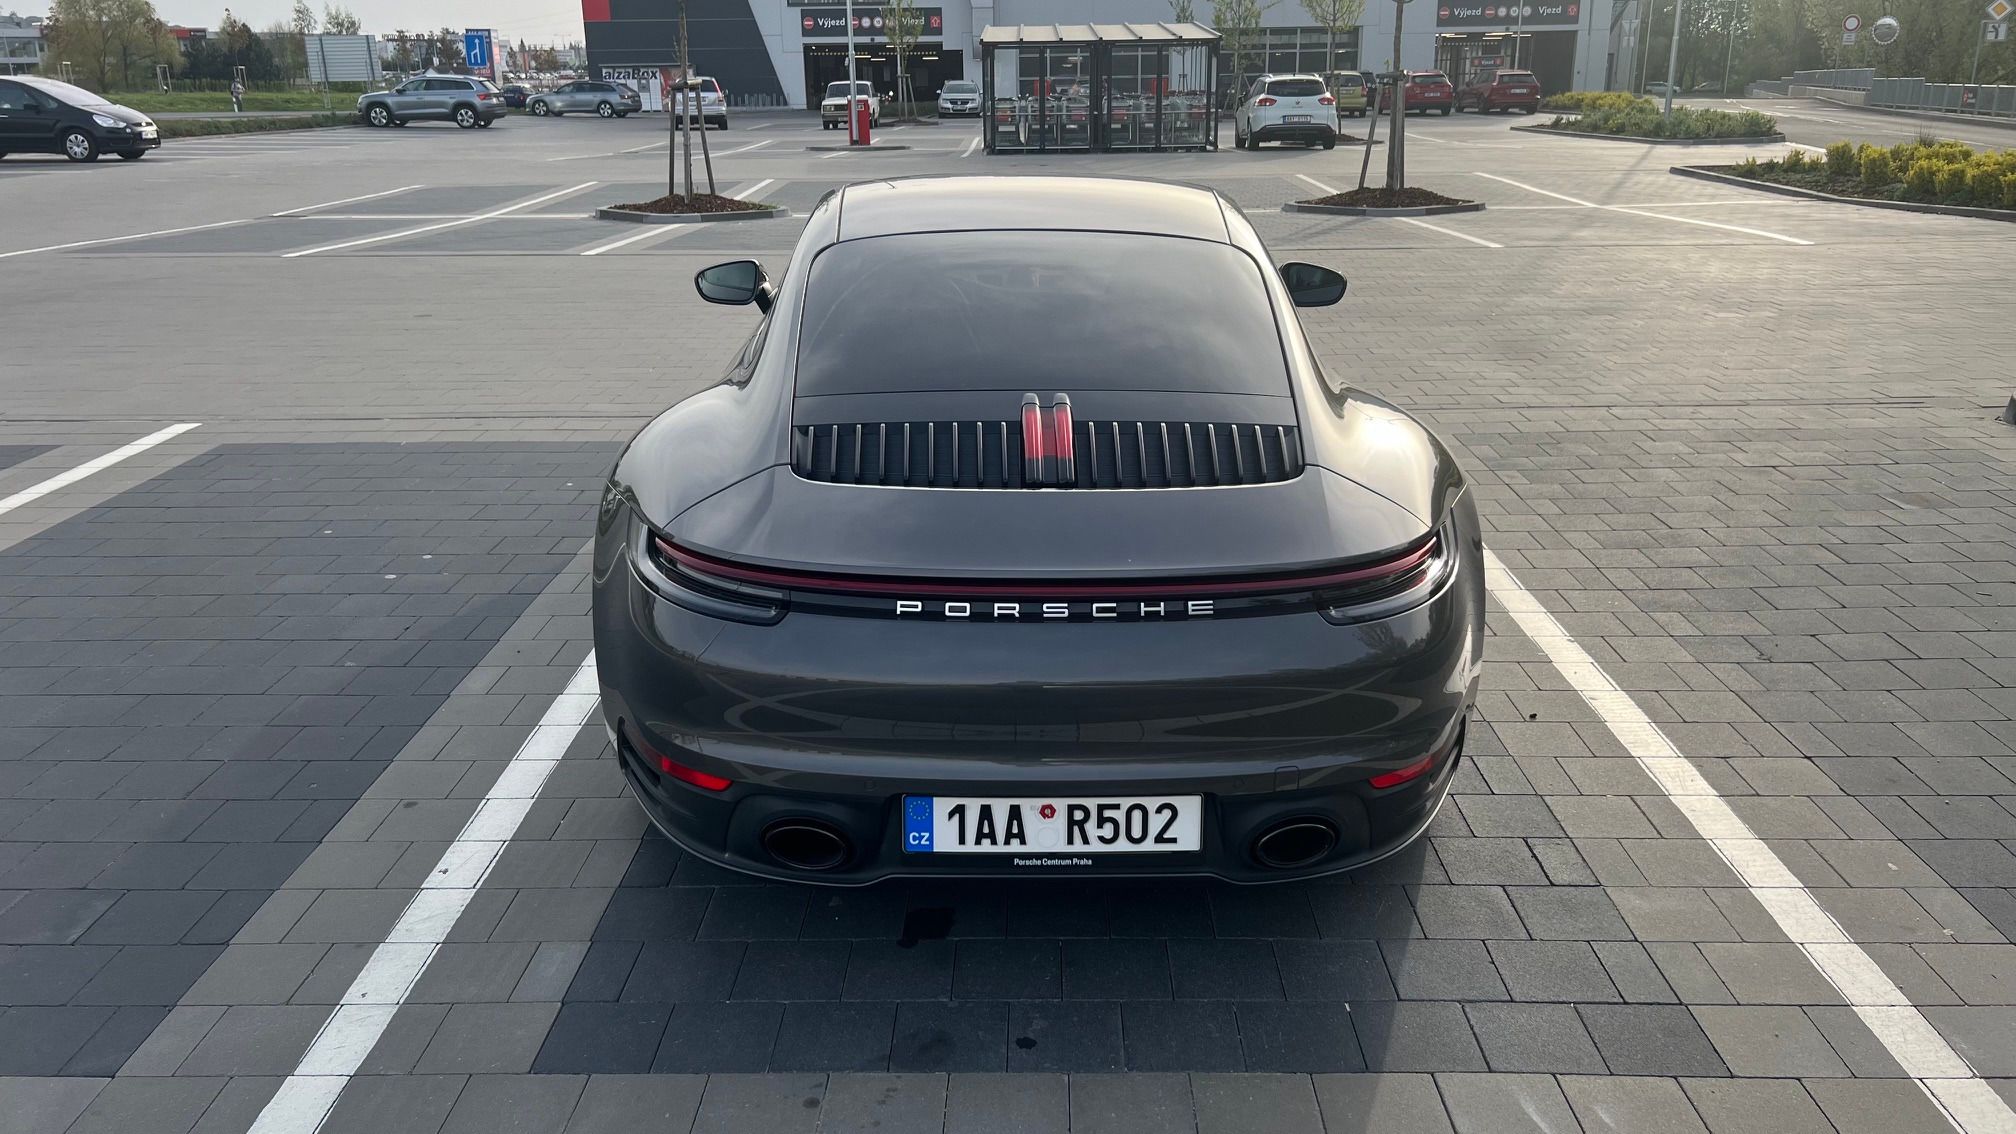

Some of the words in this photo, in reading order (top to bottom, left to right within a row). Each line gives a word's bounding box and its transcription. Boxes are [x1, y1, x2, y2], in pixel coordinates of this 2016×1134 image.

[1453, 7, 1482, 18] Výjezd
[1538, 5, 1562, 16] Vjezd
[817, 17, 846, 28] Výjezd
[896, 600, 1214, 618] PORSCHE
[947, 803, 1027, 846] 1AA
[1066, 802, 1179, 846] R502
[909, 832, 930, 845] CZ
[1014, 857, 1041, 866] Porsche
[1042, 857, 1072, 866] Centrum
[1072, 857, 1093, 866] Praha
